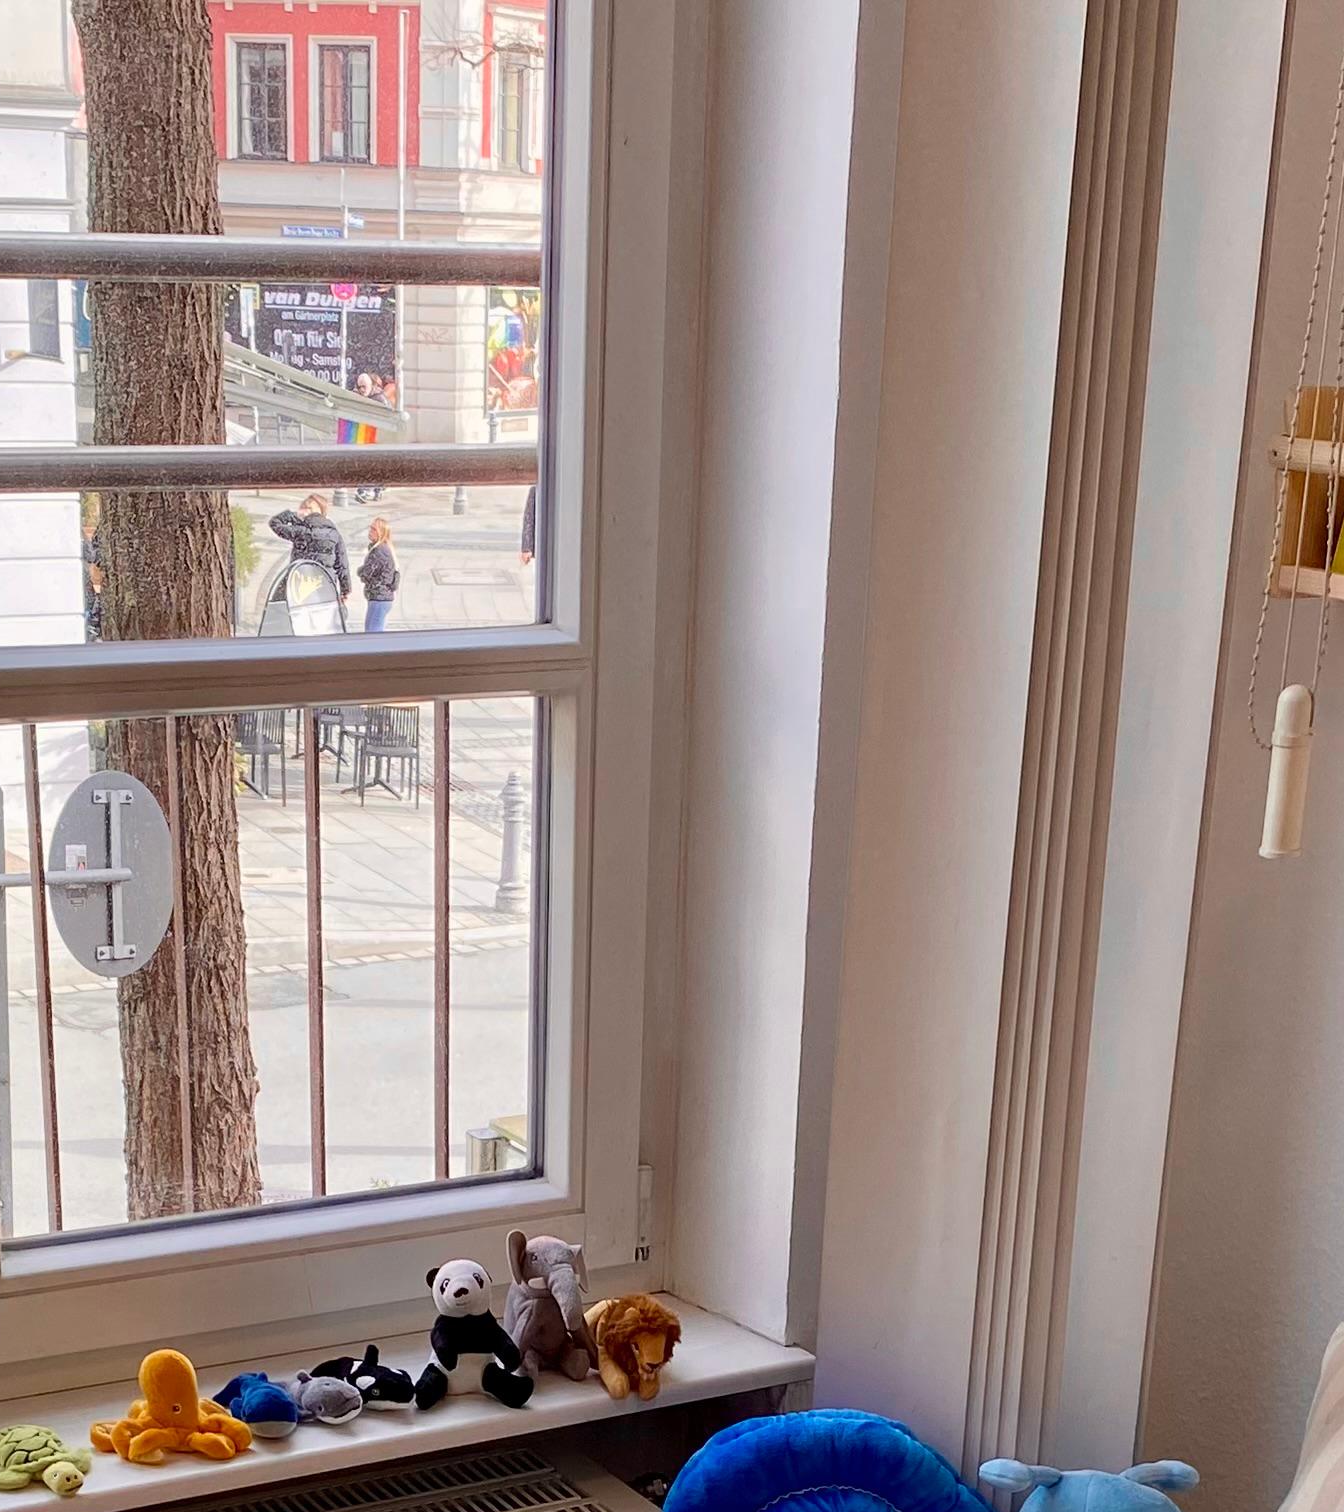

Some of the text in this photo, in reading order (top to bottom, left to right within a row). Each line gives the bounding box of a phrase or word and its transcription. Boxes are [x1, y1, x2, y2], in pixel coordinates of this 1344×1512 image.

[264, 290, 300, 306] van
[273, 329, 305, 348] Oen
[306, 330, 325, 349] für
[269, 351, 304, 368] Moag
[312, 353, 353, 370] Samstg
